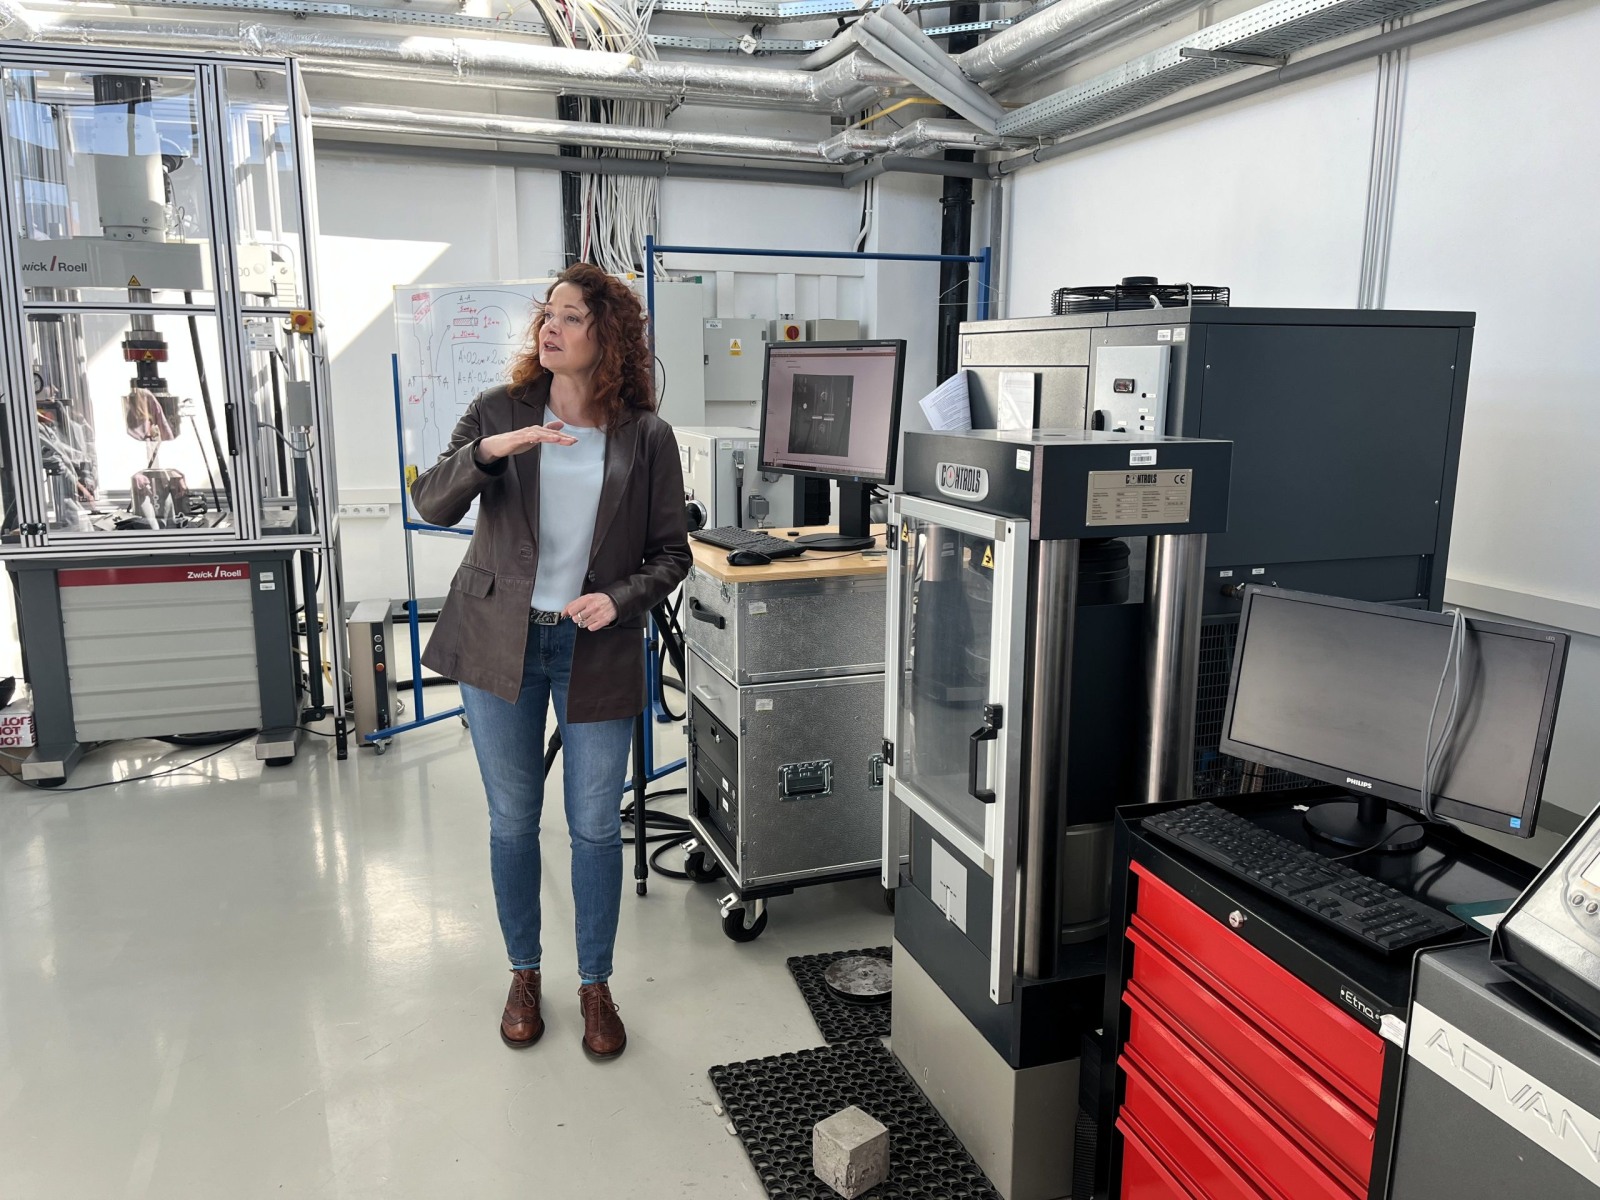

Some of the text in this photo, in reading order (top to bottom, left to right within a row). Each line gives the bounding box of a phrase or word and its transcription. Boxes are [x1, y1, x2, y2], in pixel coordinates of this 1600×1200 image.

[58, 262, 88, 273] Roell
[941, 464, 981, 494] CONTROLS
[1125, 474, 1157, 485] CONTROLS
[187, 571, 213, 579] Zwick
[220, 569, 242, 578] Roell
[1346, 776, 1373, 789] PHILIPS
[1346, 990, 1374, 1019] Etna
